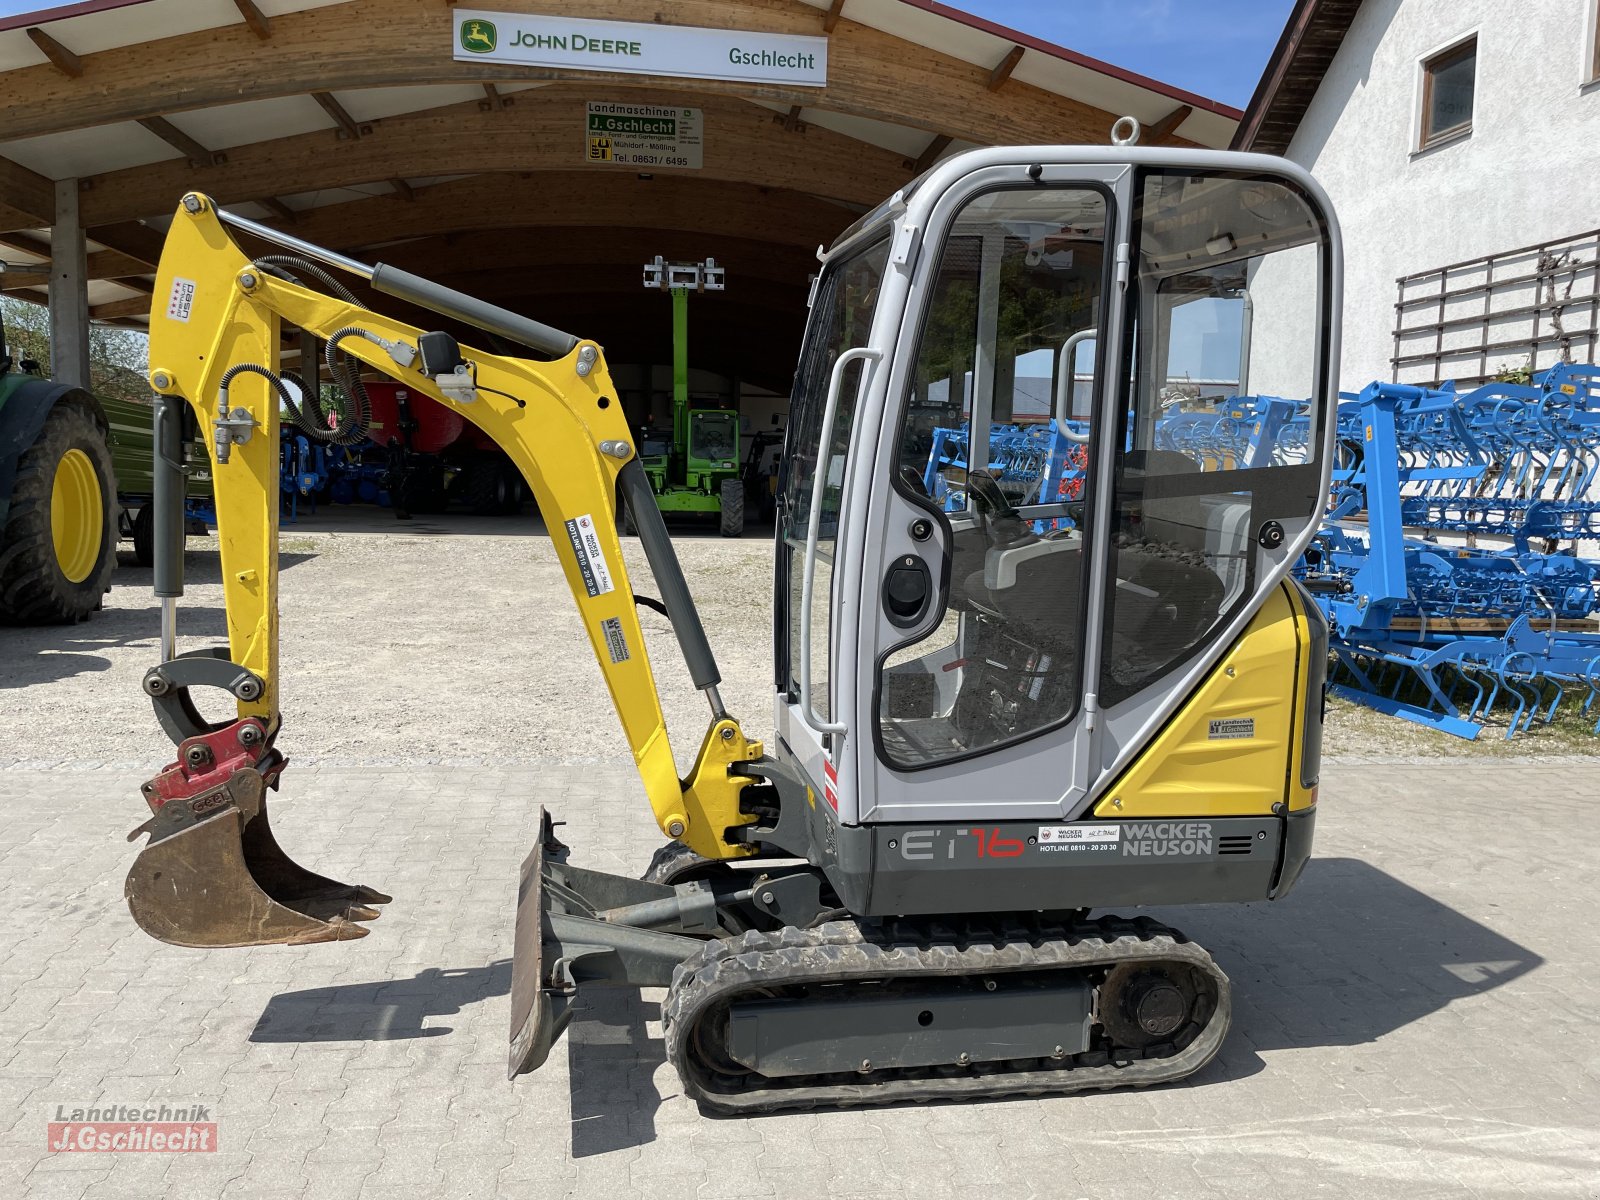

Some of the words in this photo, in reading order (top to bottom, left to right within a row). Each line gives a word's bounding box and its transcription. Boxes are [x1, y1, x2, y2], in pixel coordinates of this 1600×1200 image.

[510, 30, 567, 50] JOHN
[572, 34, 642, 56] DEERE
[729, 47, 815, 70] Gschlecht
[588, 102, 676, 117] Landmaschinen
[592, 118, 602, 129] J.
[606, 118, 673, 133] Gschlecht
[614, 141, 644, 149] Mühldorf
[613, 154, 630, 163] Tel.
[182, 284, 194, 318] used
[567, 521, 581, 550] HOTLINE
[584, 570, 590, 578] 20
[590, 587, 596, 595] 30
[1122, 823, 1212, 839] WACKER
[1122, 840, 1212, 856] NEUSON
